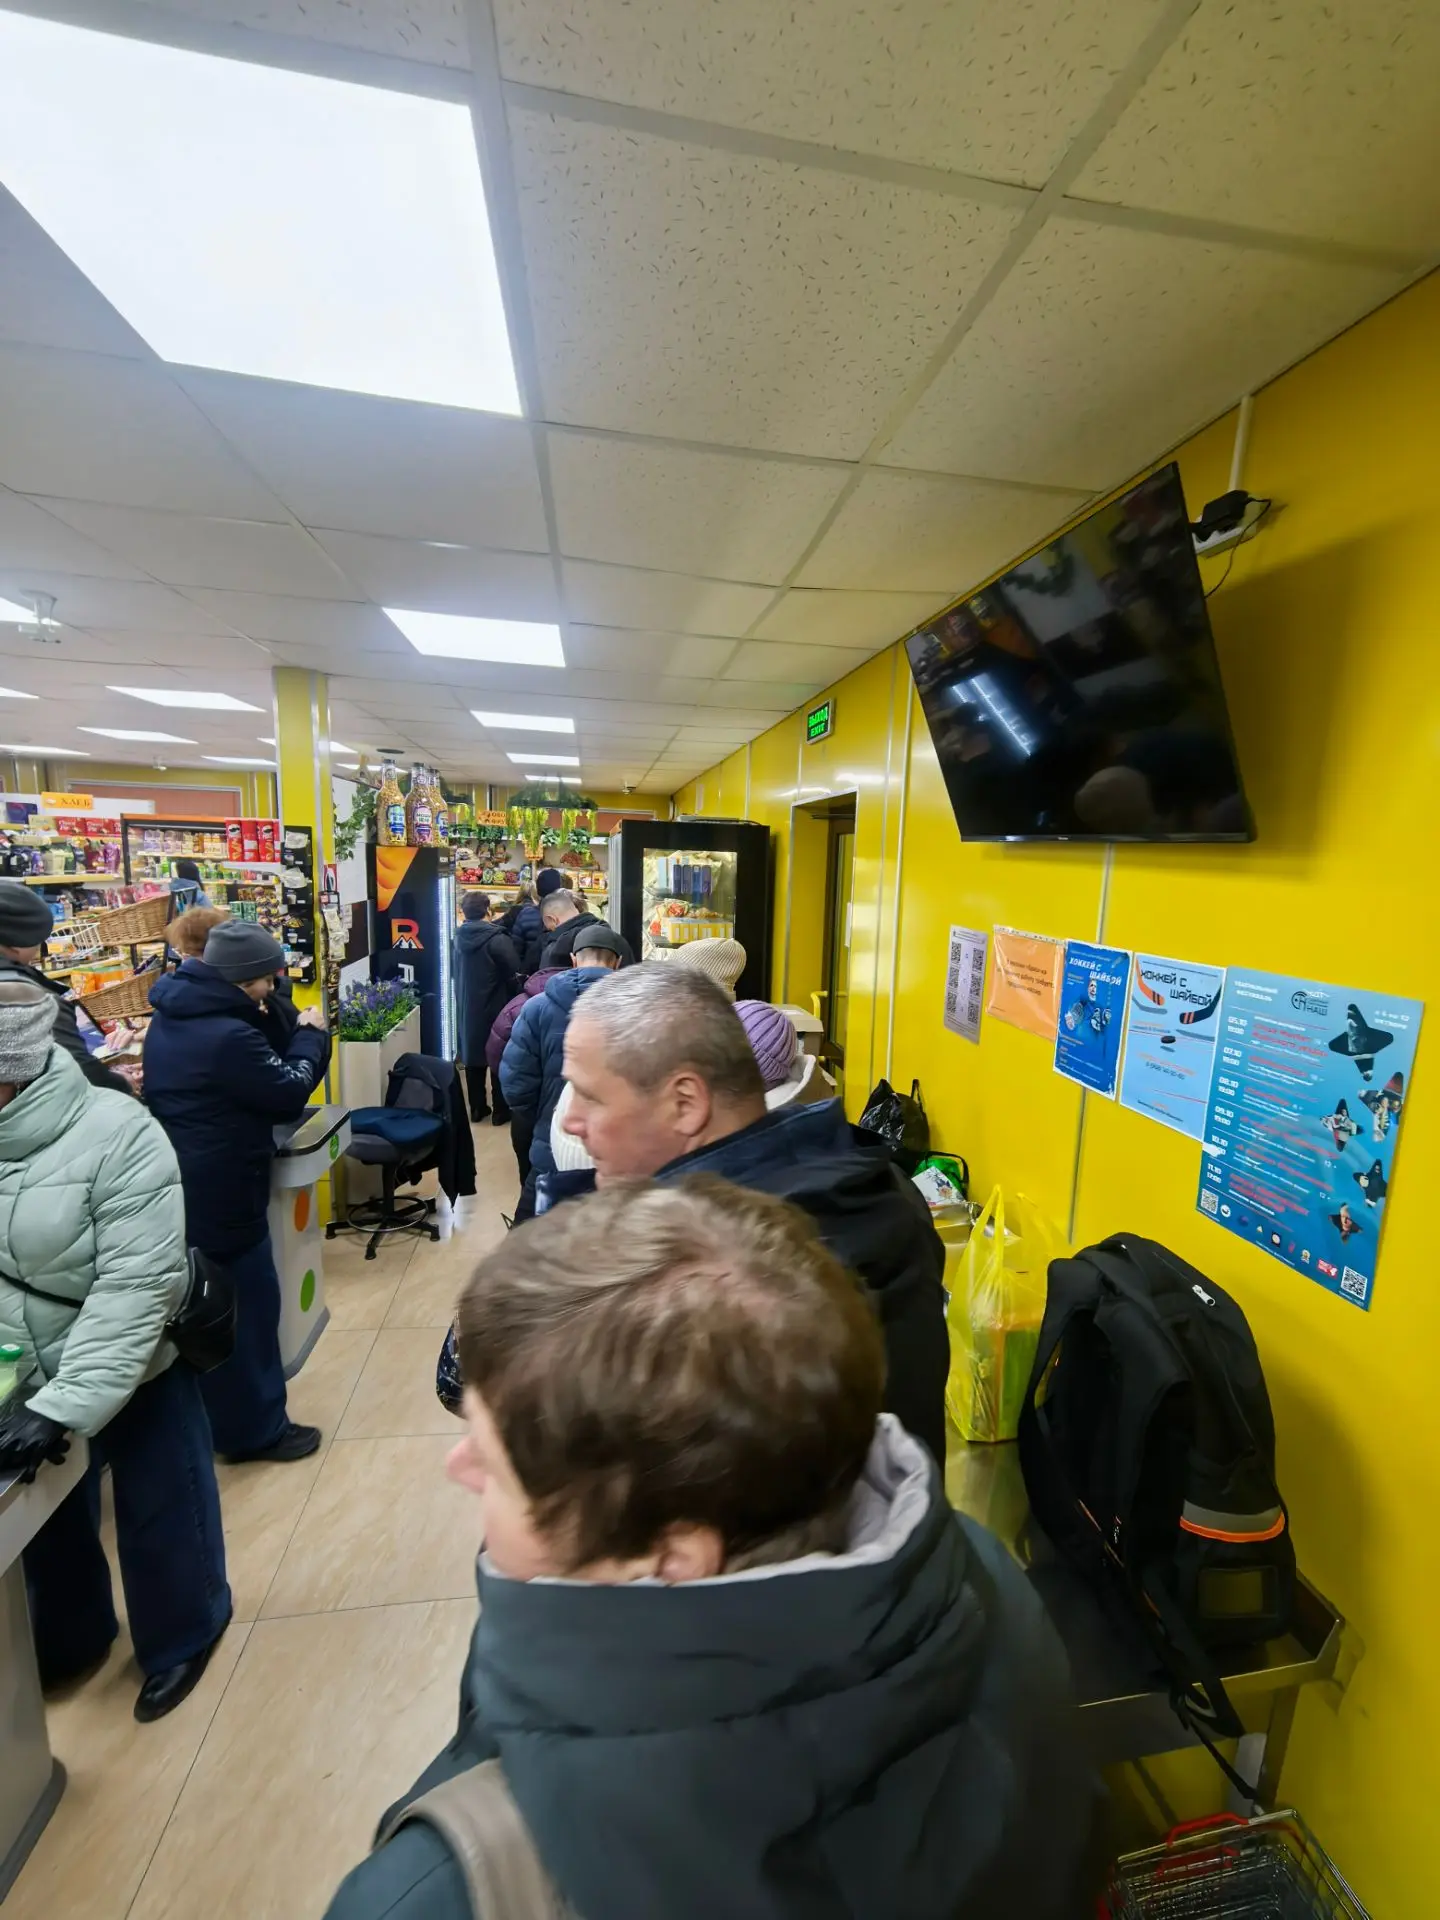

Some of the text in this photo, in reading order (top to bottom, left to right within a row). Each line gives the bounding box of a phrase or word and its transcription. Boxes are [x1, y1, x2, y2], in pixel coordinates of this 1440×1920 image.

[809, 706, 828, 728] ВЫХОД
[810, 723, 826, 737] EXIT
[1069, 956, 1097, 970] ХОККЕЙ
[1095, 963, 1102, 972] С
[1089, 970, 1122, 986] ШАЙБОЙ
[1140, 969, 1177, 986] ХОККЕЙ
[1179, 977, 1188, 988] С
[1170, 988, 1213, 1007] ШАЙБОЙ
[1214, 1105, 1234, 1118] 09.10
[1211, 1134, 1228, 1147] 10.10
[1207, 1162, 1222, 1175] 11.10
[1206, 1171, 1222, 1184] 17:00
